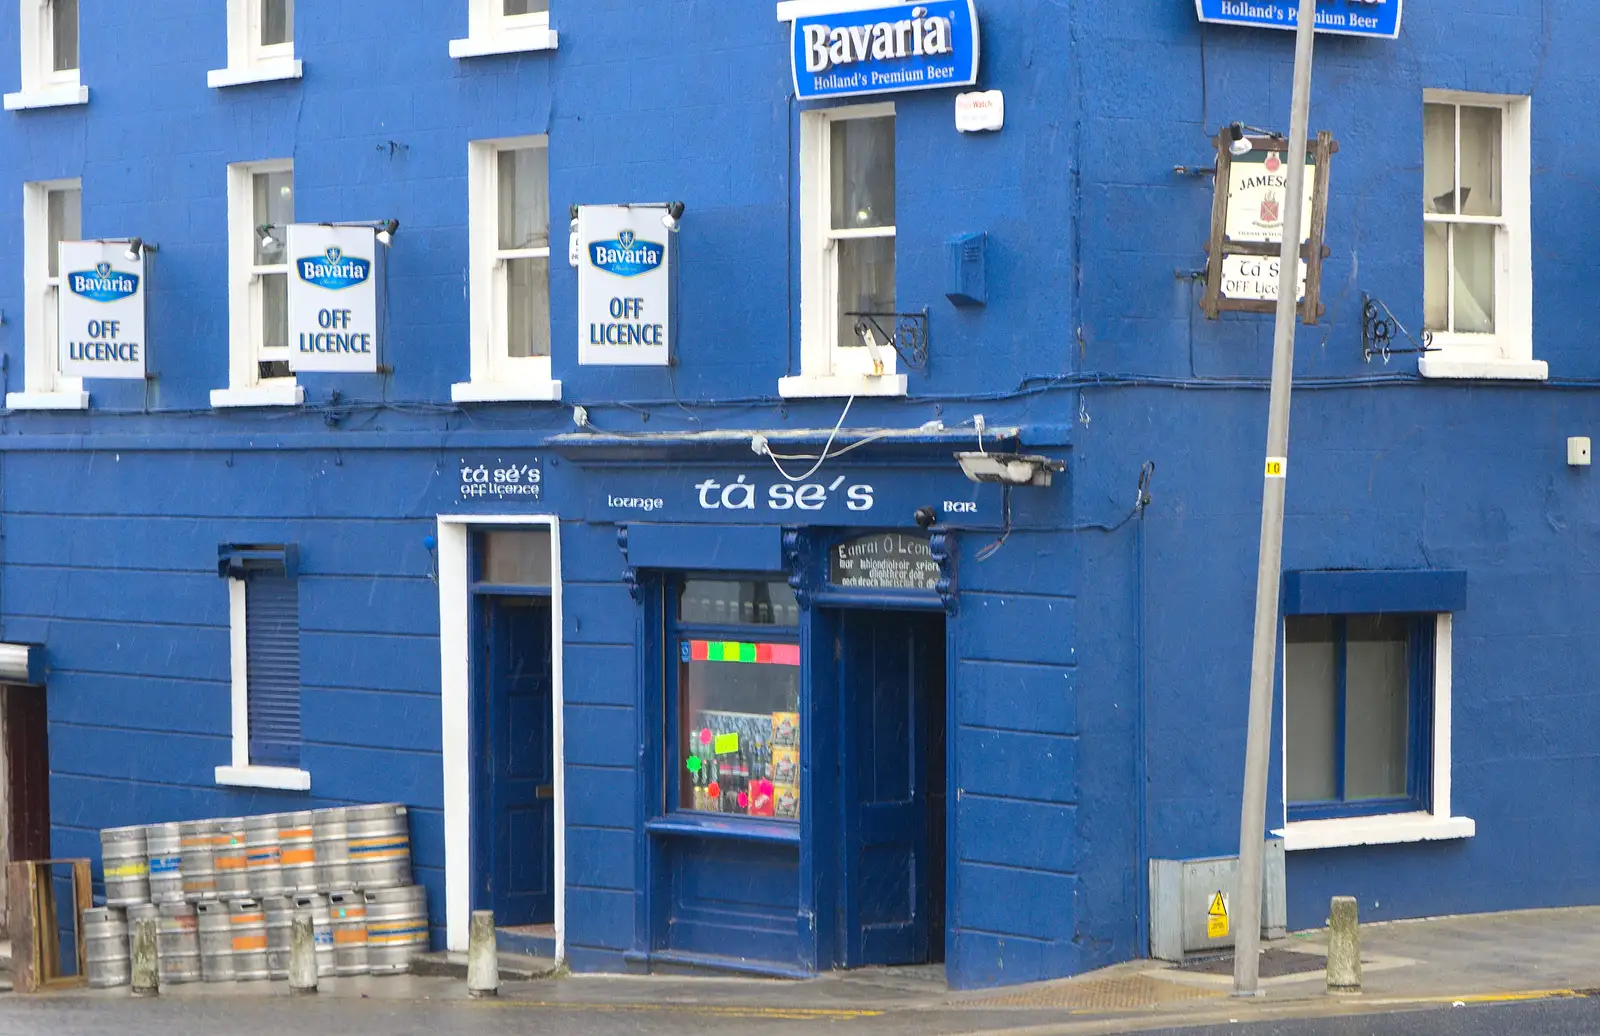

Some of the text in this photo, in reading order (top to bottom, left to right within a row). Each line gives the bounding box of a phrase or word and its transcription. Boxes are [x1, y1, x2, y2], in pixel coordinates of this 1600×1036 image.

[1221, 1, 1283, 20] Holland's
[1350, 13, 1378, 28] Beer
[803, 6, 952, 73] Bavaria
[814, 65, 954, 91] Holland's Premium Beer
[1240, 175, 1288, 191] JAMES
[595, 246, 657, 265] Bavaria
[304, 262, 364, 279] Bavaria
[74, 275, 133, 293] Bavaria
[318, 308, 351, 329] OFF
[609, 297, 644, 319] OFF
[87, 319, 120, 339] OFF
[590, 323, 663, 345] LICENCE
[70, 342, 139, 361] LICENCE
[300, 332, 370, 353] LICENCE
[1267, 462, 1280, 474] 10
[694, 474, 755, 510] tá
